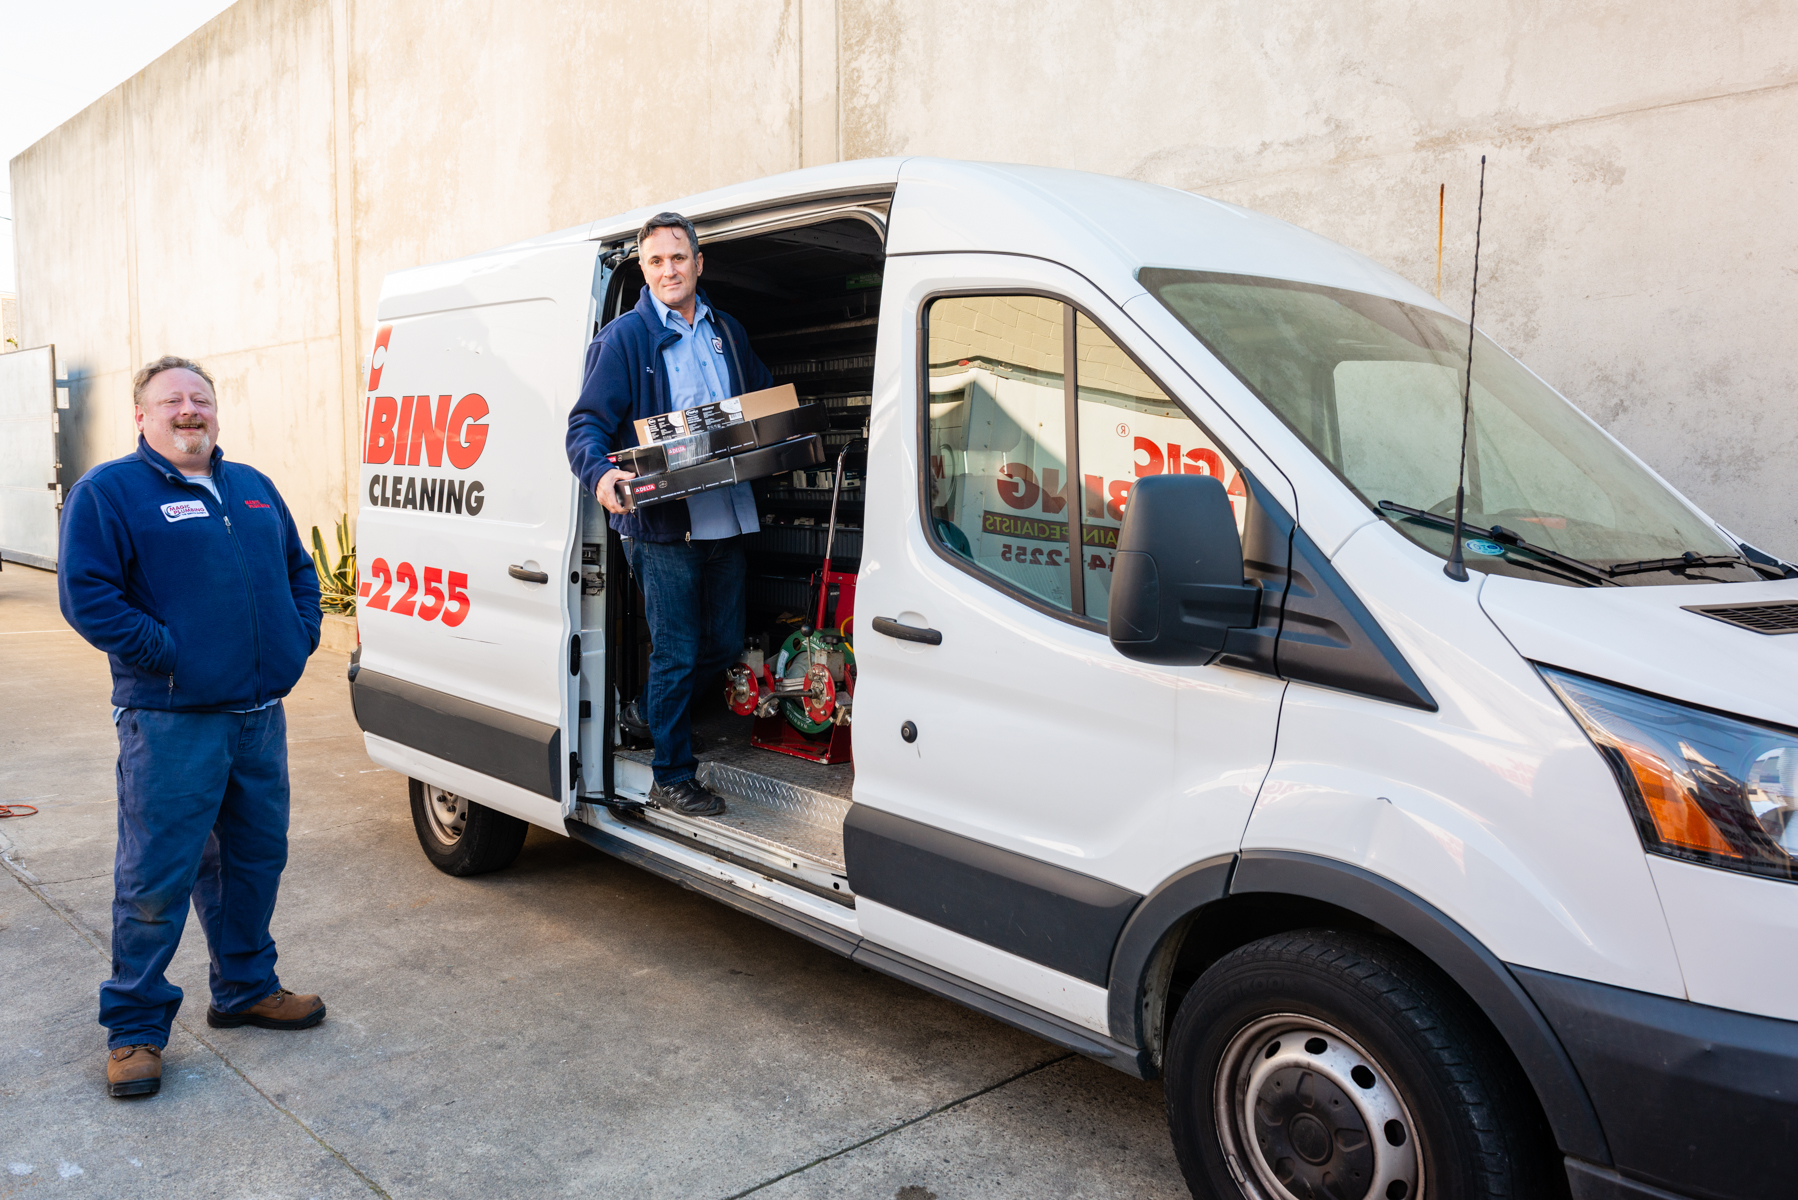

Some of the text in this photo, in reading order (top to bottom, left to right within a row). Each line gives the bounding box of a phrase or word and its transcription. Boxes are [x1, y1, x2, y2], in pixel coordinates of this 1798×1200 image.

[363, 393, 489, 469] BING
[369, 474, 484, 516] CLEANING
[639, 484, 655, 493] DELTA
[169, 504, 191, 512] MAGIC
[173, 507, 205, 515] PLUMBING
[358, 557, 470, 627] -2255
